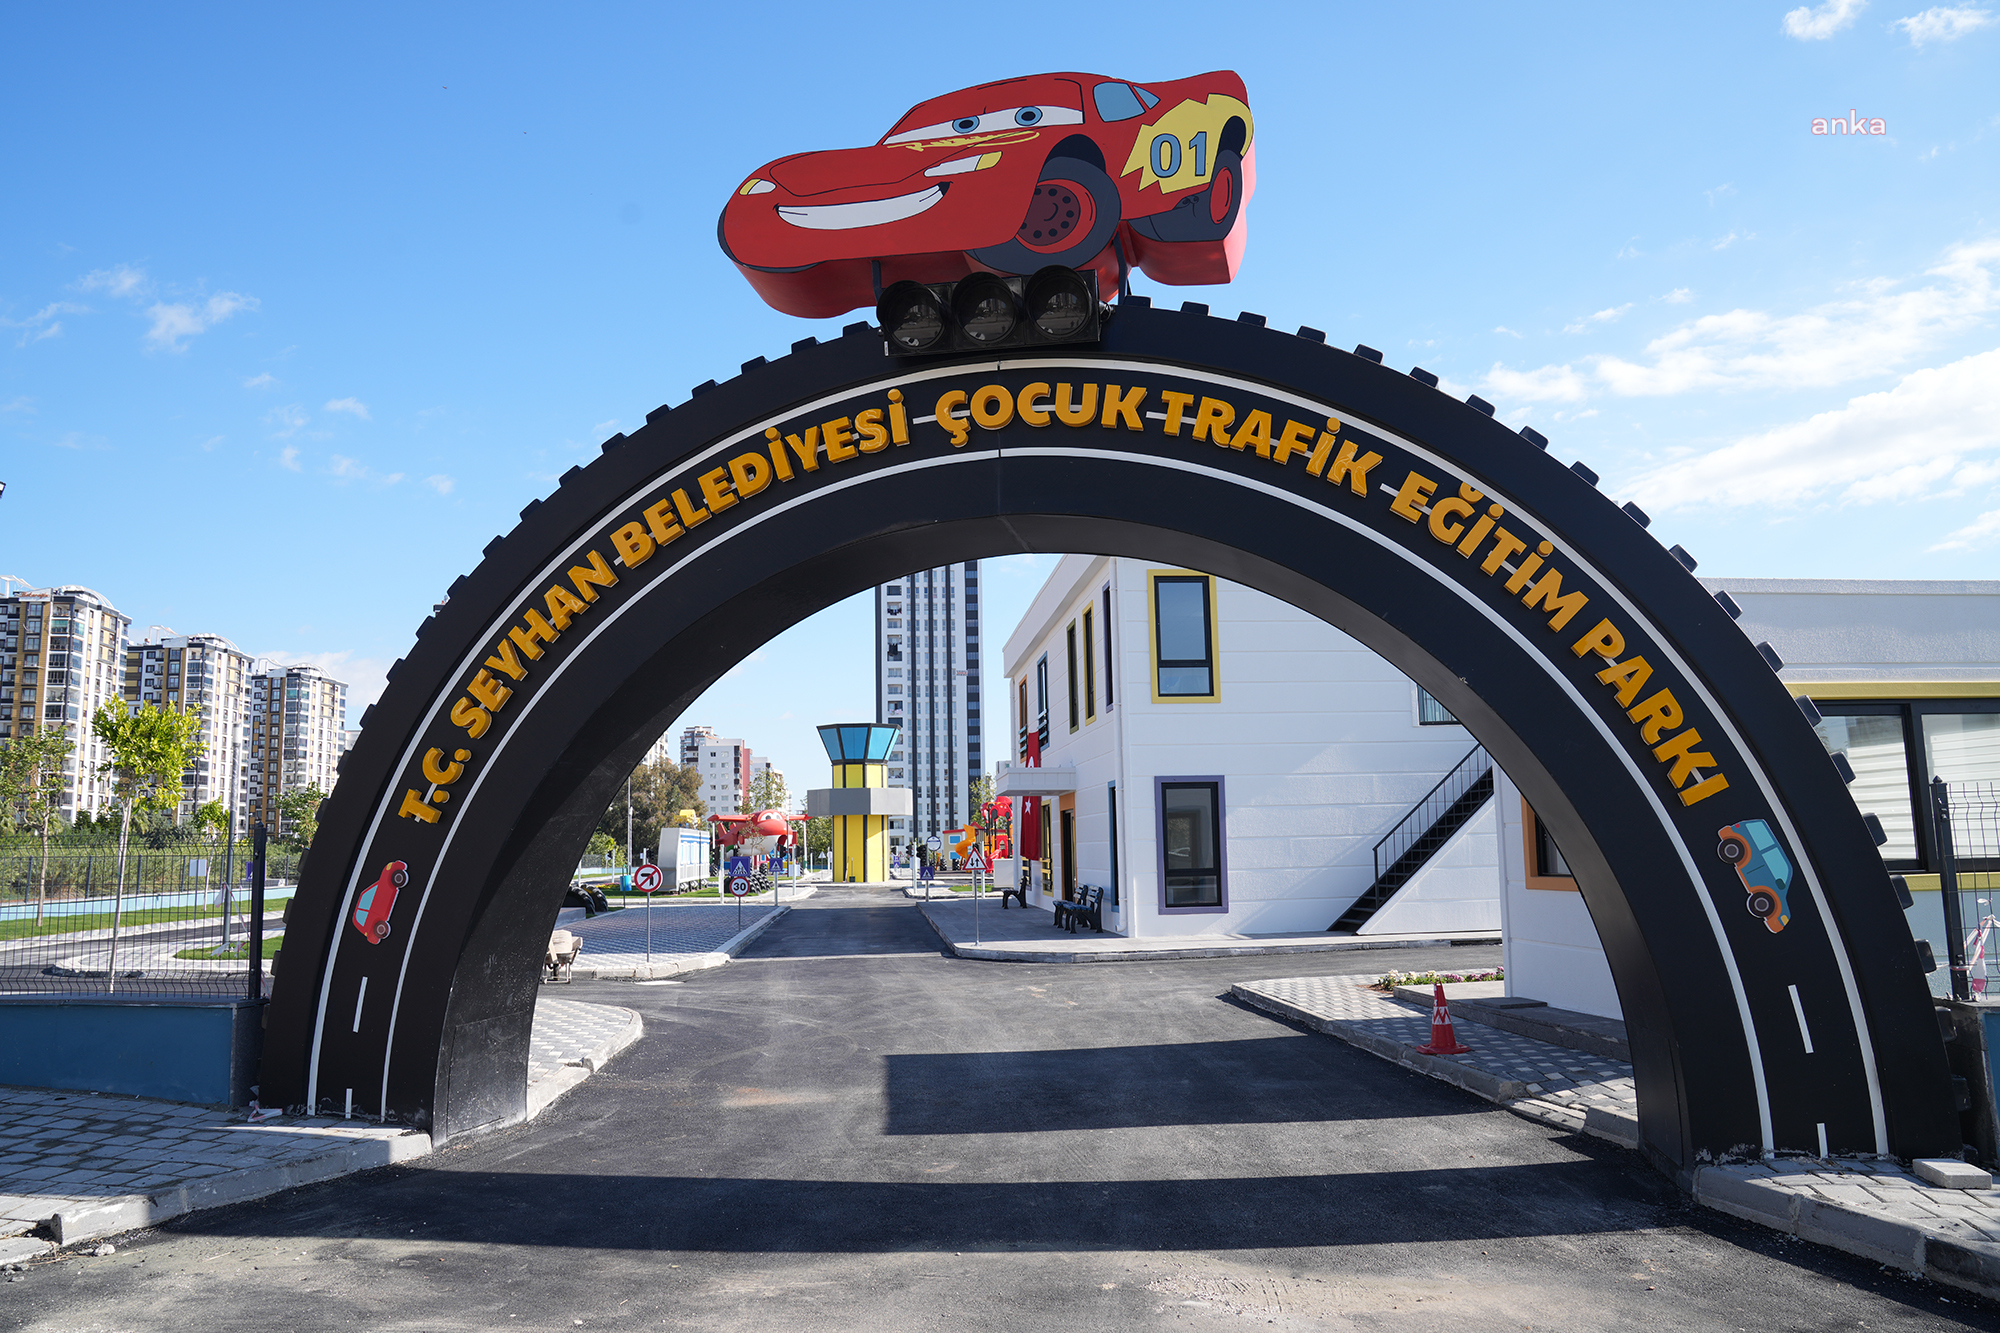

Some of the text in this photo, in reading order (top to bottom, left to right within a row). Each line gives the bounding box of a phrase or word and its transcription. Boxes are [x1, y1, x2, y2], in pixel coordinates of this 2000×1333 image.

[1150, 131, 1207, 178] 01
[397, 381, 1730, 824] T.C. SEYHAN BELEDİYESİ ÇOCUK TRAFİK EĞİTİM PARKI
[733, 882, 747, 891] 30
